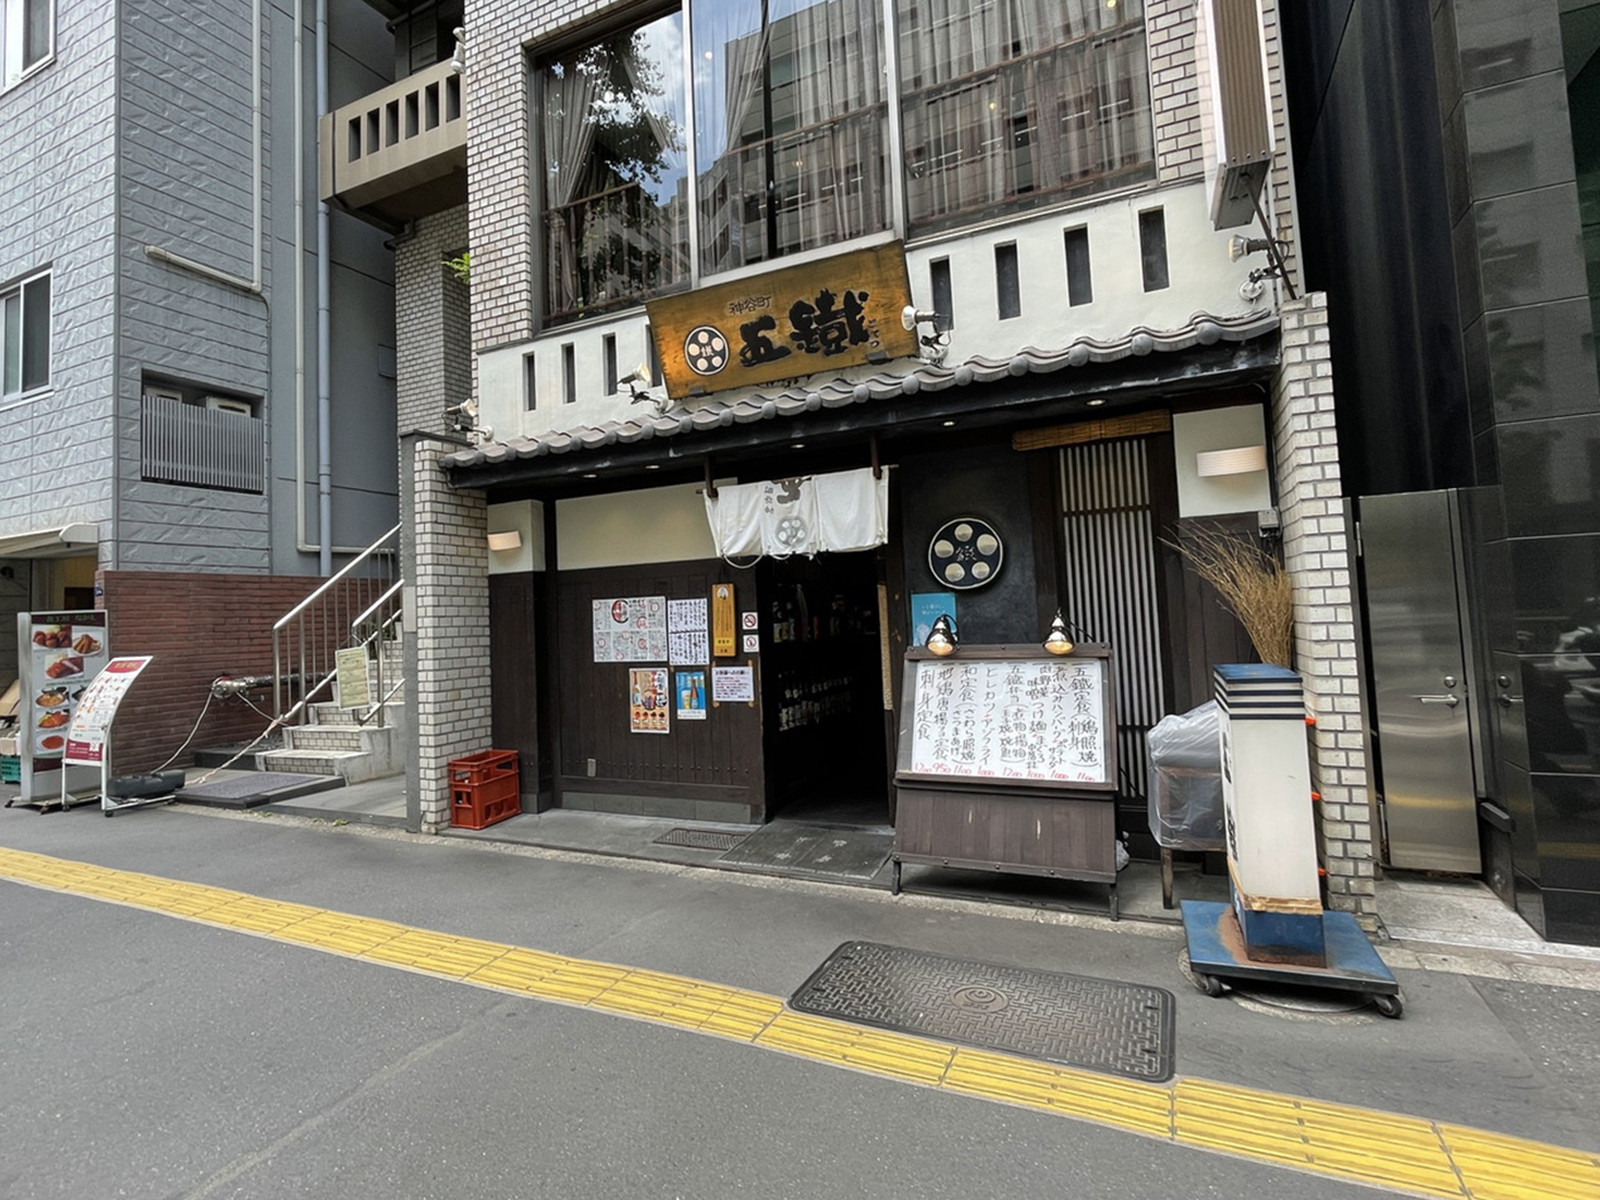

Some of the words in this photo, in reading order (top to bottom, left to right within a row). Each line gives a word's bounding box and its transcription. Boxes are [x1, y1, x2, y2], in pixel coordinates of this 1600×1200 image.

[729, 296, 771, 315] 神谷町
[917, 669, 935, 741] 刺身定食
